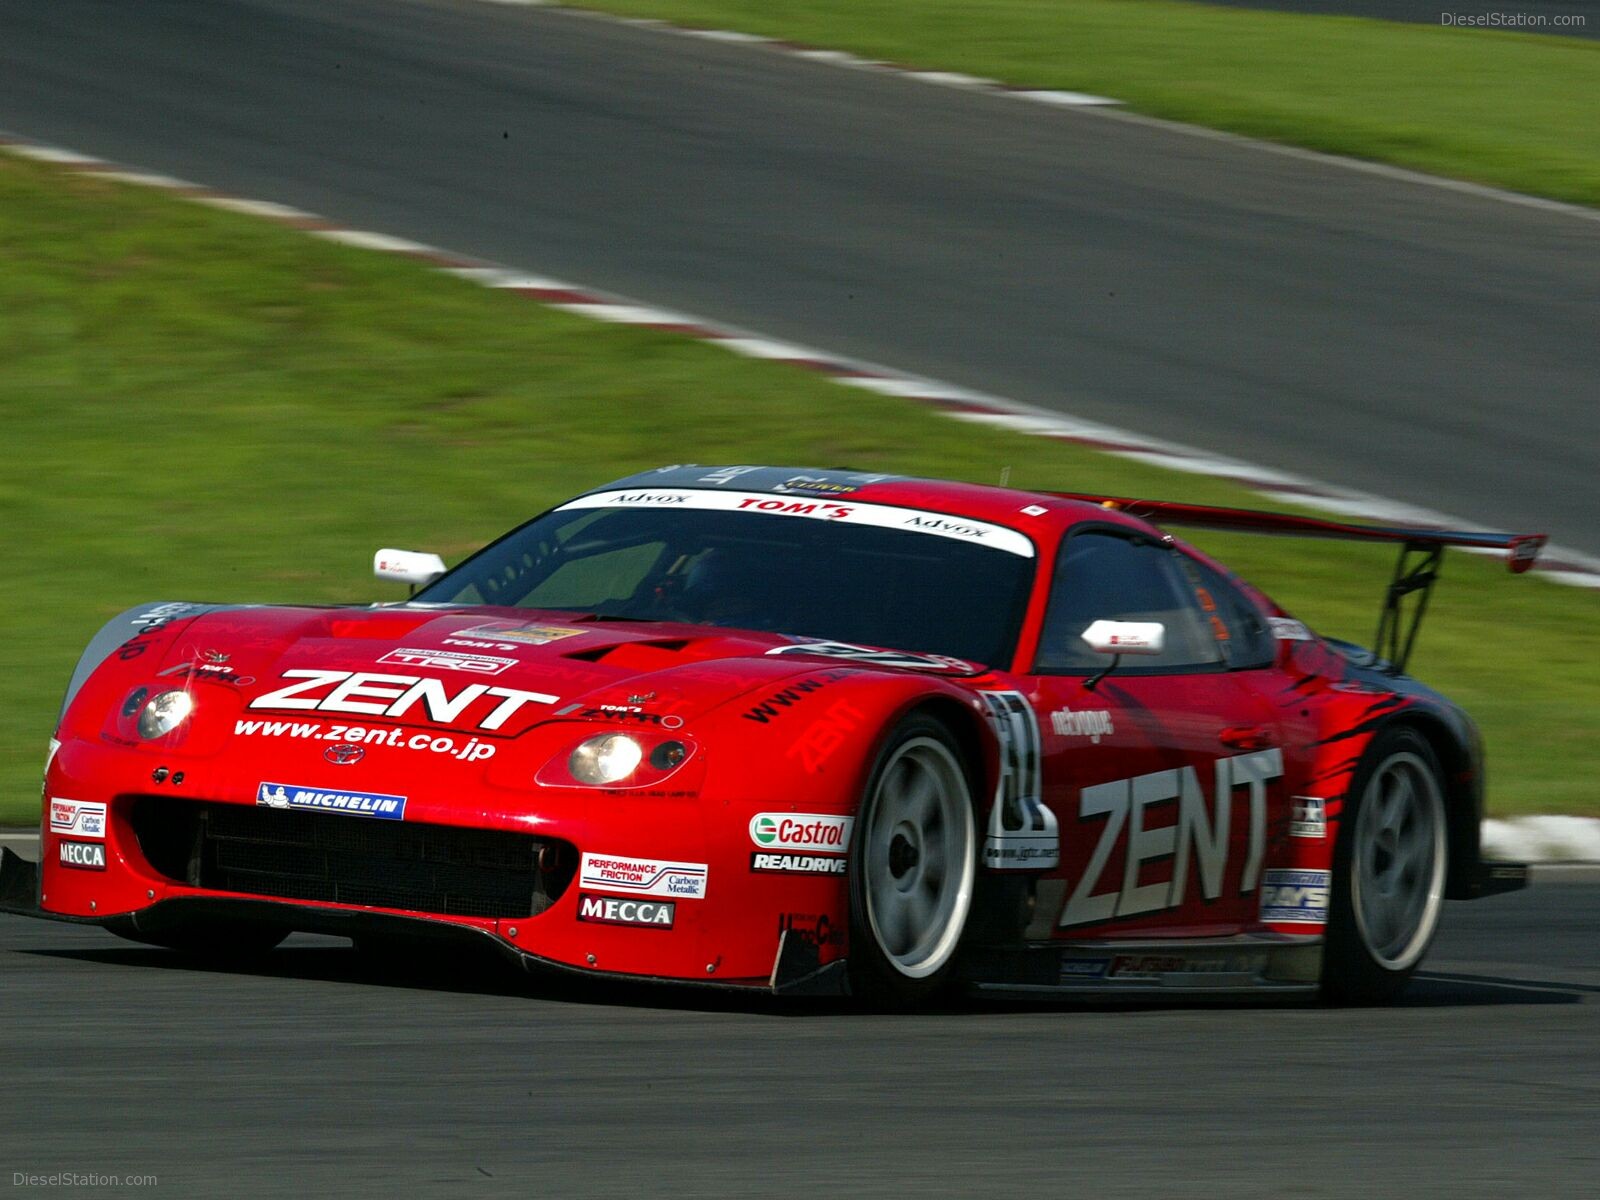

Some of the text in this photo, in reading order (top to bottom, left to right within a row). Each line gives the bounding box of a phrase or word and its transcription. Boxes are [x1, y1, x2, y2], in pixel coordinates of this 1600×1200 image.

[738, 498, 854, 519] TOM'S
[394, 654, 498, 670] TRD
[249, 668, 560, 731] ZENT
[234, 719, 496, 761] www.zent.co.jp
[293, 791, 397, 813] MICHELIN
[778, 819, 845, 846] Castrol
[1060, 748, 1284, 927] ZENT
[60, 843, 105, 866] MECCA
[754, 854, 847, 873] REALDRIVE
[588, 858, 656, 874] PERFORMANCE
[600, 869, 643, 882] FRICTION
[667, 884, 700, 895] Metallic
[669, 875, 699, 886] Carbon
[580, 897, 671, 925] MECCA
